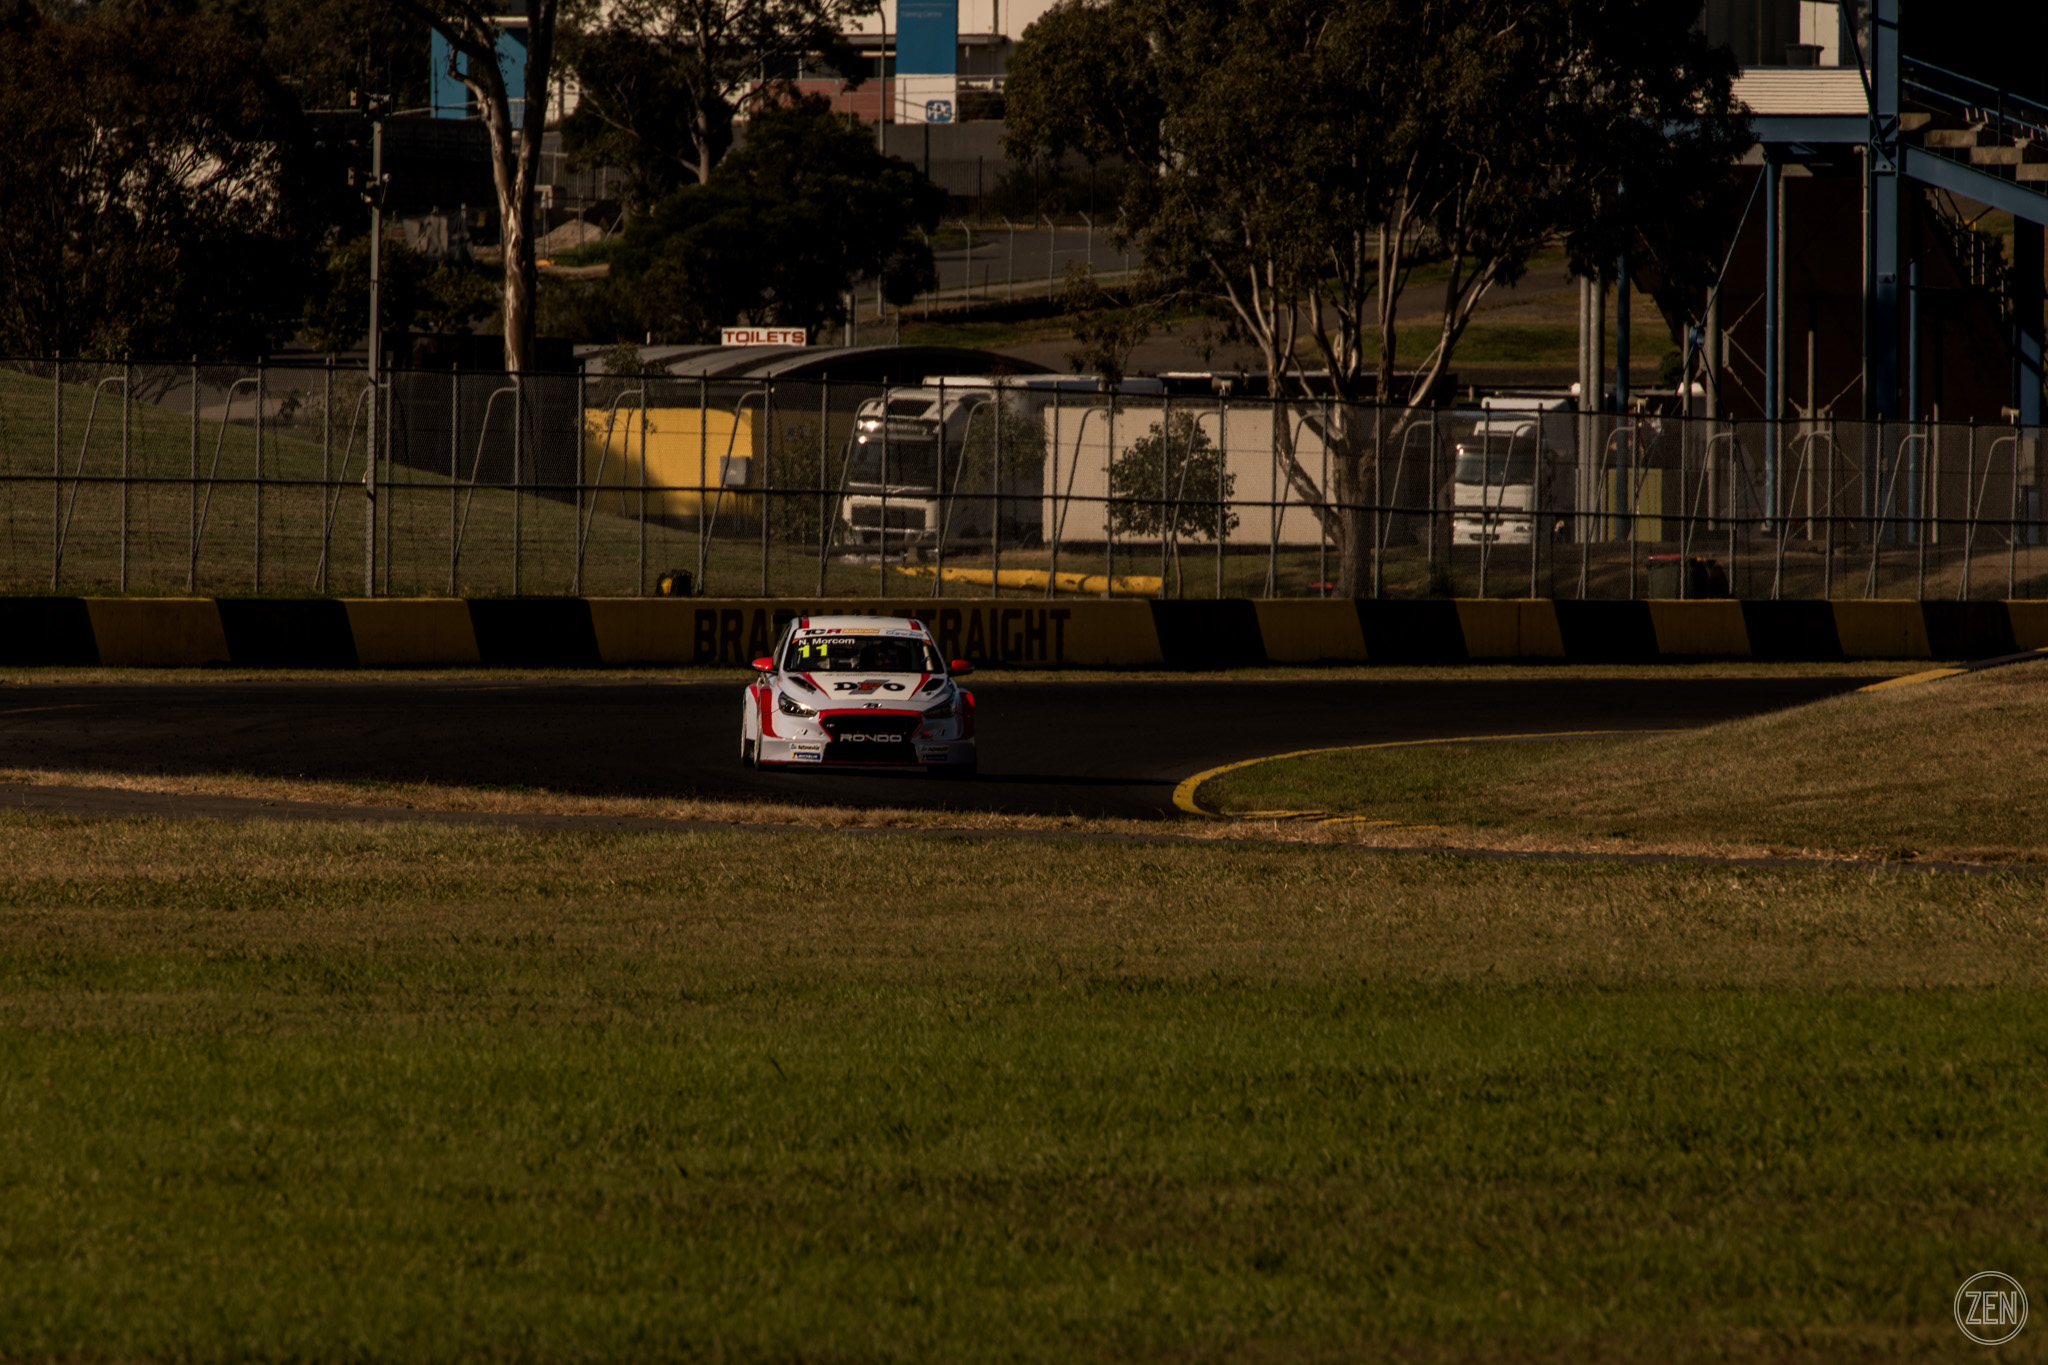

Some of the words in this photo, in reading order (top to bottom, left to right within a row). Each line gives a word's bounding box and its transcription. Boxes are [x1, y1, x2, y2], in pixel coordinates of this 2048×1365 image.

[723, 331, 804, 343] TOILETS
[812, 638, 855, 646] Morcom
[798, 644, 828, 658] 11
[834, 682, 906, 691] DFO
[840, 733, 902, 742] RONDO
